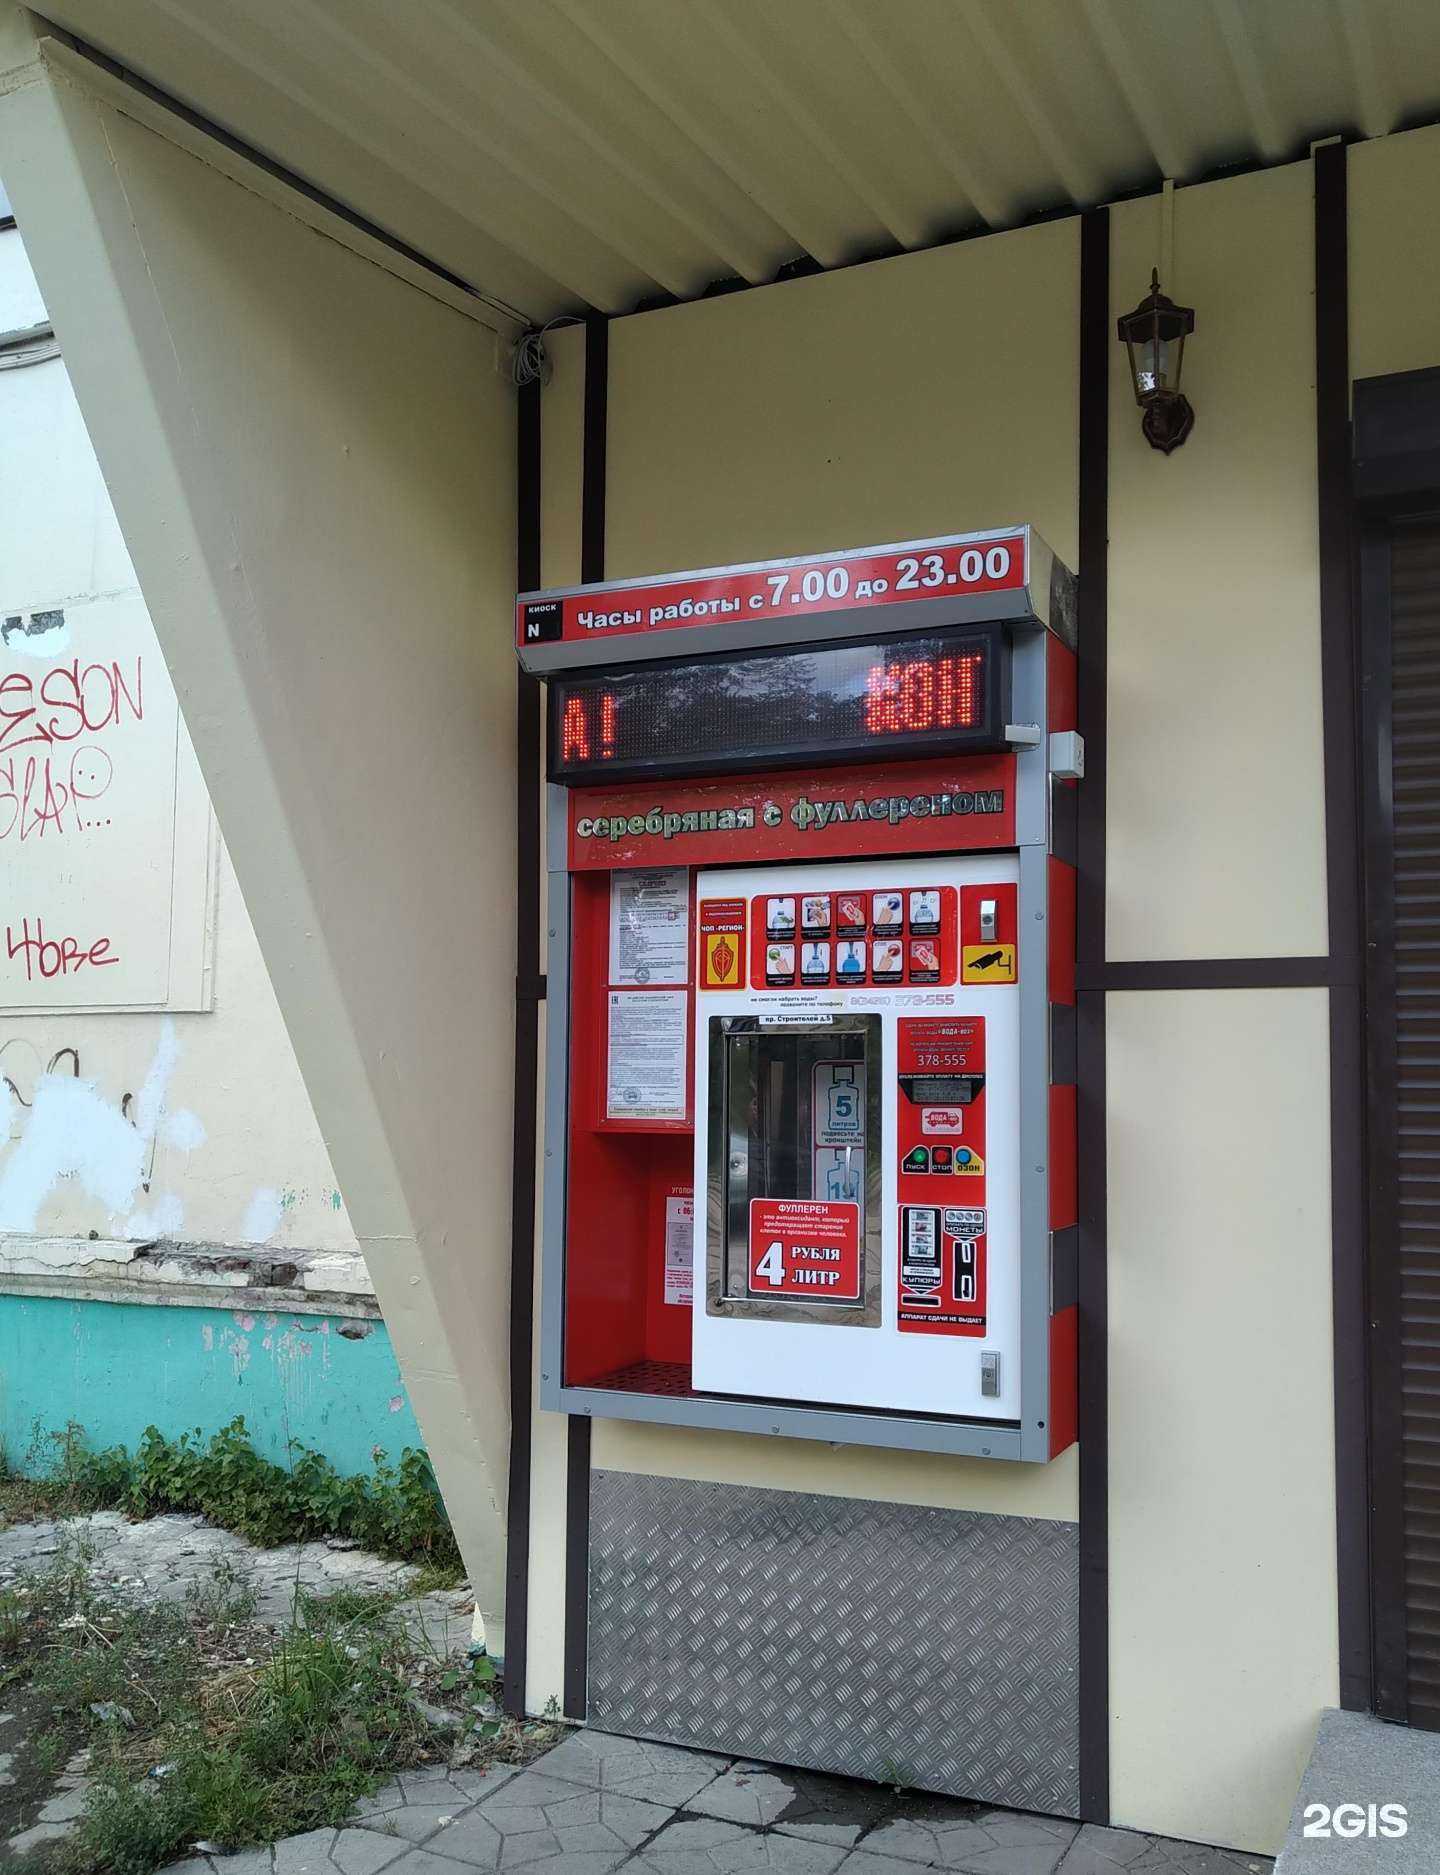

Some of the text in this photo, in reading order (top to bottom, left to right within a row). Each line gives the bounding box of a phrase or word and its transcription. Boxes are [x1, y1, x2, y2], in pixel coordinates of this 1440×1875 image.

[577, 547, 1010, 629] Часы работы с 7.00 до 23.00
[527, 623, 540, 638] N
[576, 790, 1004, 841] серебряная с фуллереном
[777, 1015, 818, 1023] Строителей
[918, 1054, 967, 1066] 378-555
[836, 1095, 852, 1117] 5
[778, 1204, 829, 1214] ФУЛЛЕРЕН
[791, 1246, 841, 1261] РУБЛЯ
[755, 1241, 786, 1287] 4
[791, 1269, 841, 1285] ЛИТР
[902, 1276, 941, 1285] КУПЮРЫ
